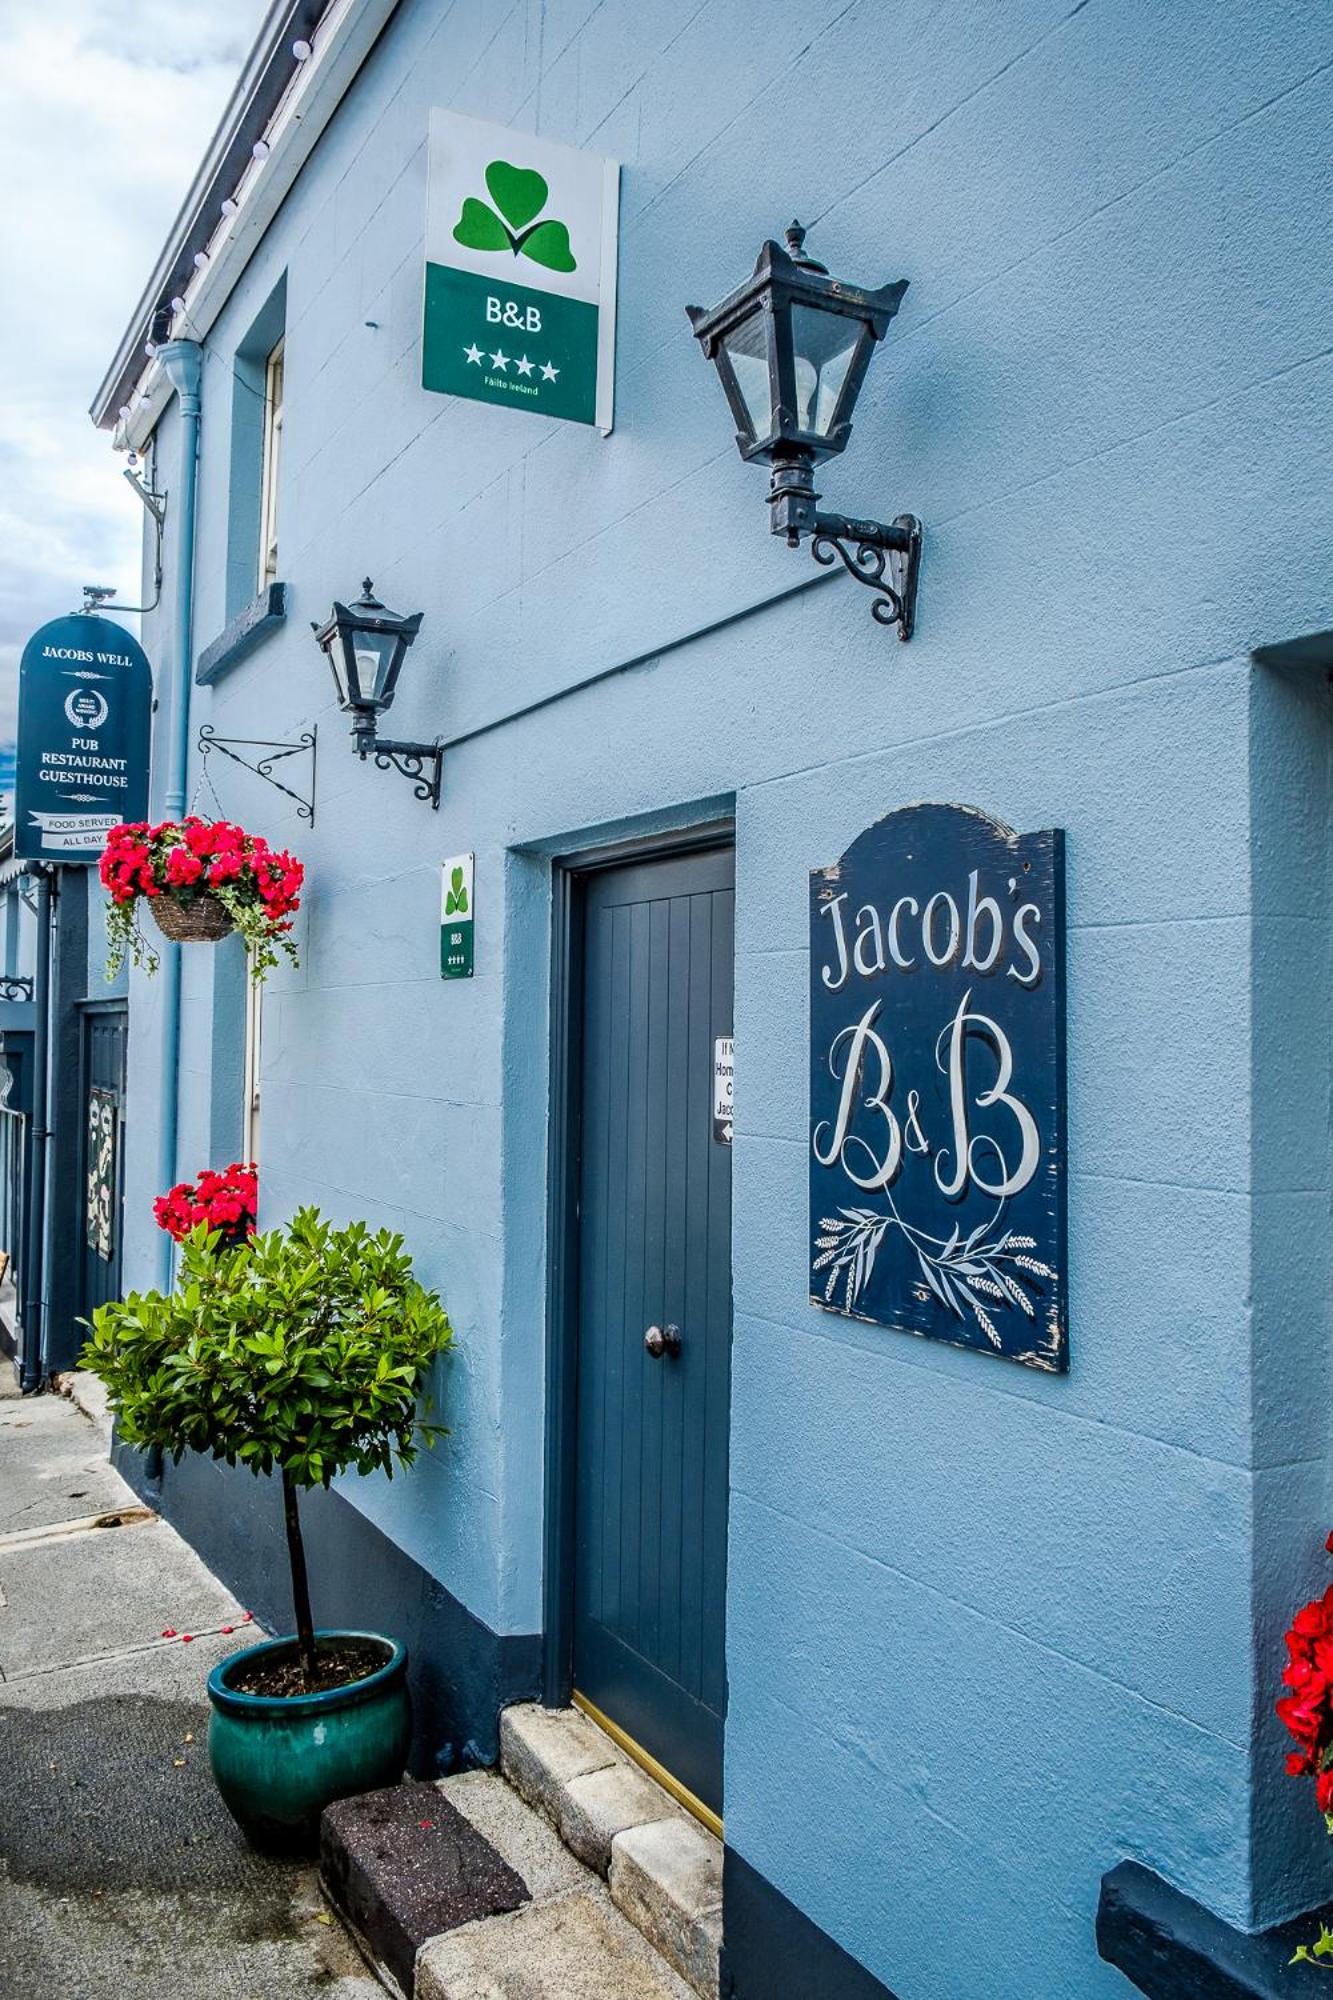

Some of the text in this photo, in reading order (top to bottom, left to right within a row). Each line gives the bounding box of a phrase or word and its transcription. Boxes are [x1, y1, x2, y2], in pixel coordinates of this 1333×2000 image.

[486, 296, 542, 333] B&B
[42, 646, 133, 667] JACOBS WELL
[71, 737, 99, 751] PUB
[41, 752, 128, 771] RESTAURANT
[39, 769, 129, 788] GUESTHOUSE
[48, 818, 118, 829] FOOD SERVED
[63, 834, 103, 846] ALL DAY
[820, 869, 1041, 989] Jacob's
[715, 1062, 735, 1077] Hom
